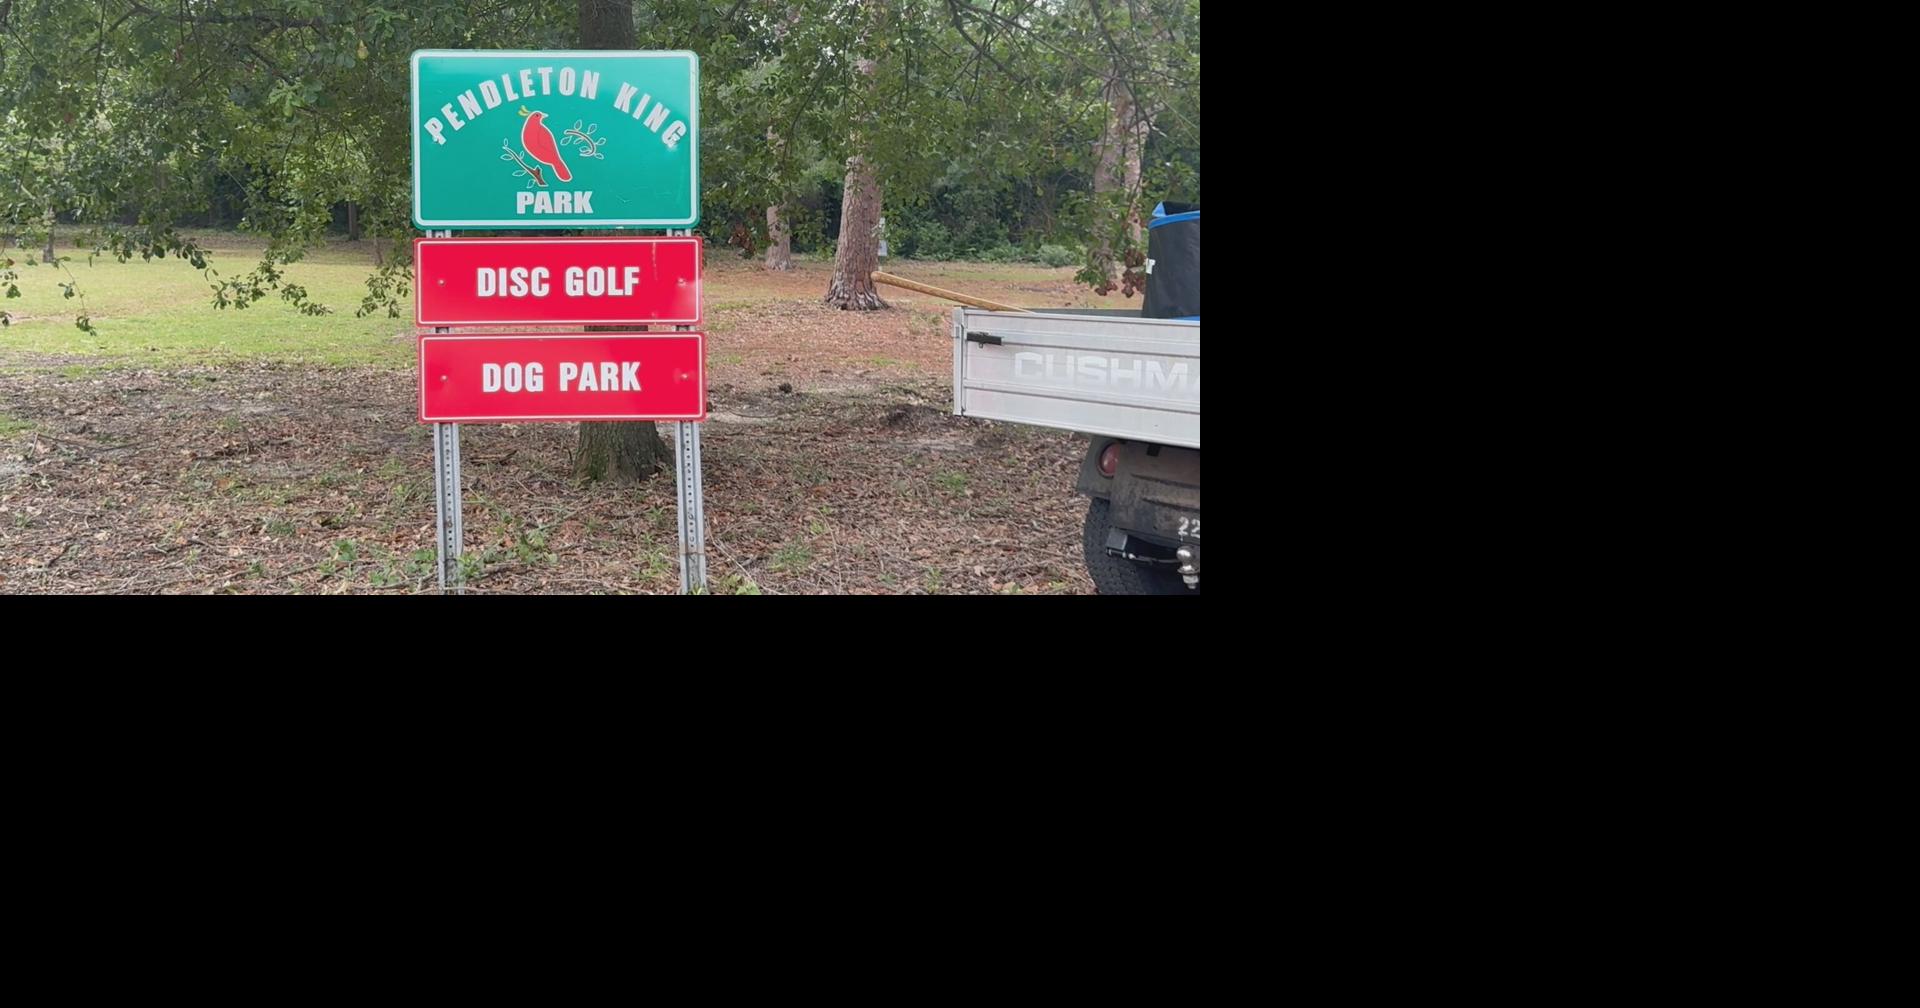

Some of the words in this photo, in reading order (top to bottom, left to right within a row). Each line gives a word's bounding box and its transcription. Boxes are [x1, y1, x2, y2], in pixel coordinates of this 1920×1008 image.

[424, 67, 600, 145] PENDLETON
[613, 82, 687, 148] KING
[516, 191, 593, 214] PARK
[477, 266, 550, 297] DISC
[565, 266, 640, 297] GOLF
[482, 362, 544, 393] DOG
[559, 361, 642, 392] PARK
[1015, 351, 1200, 393] CUSHM
